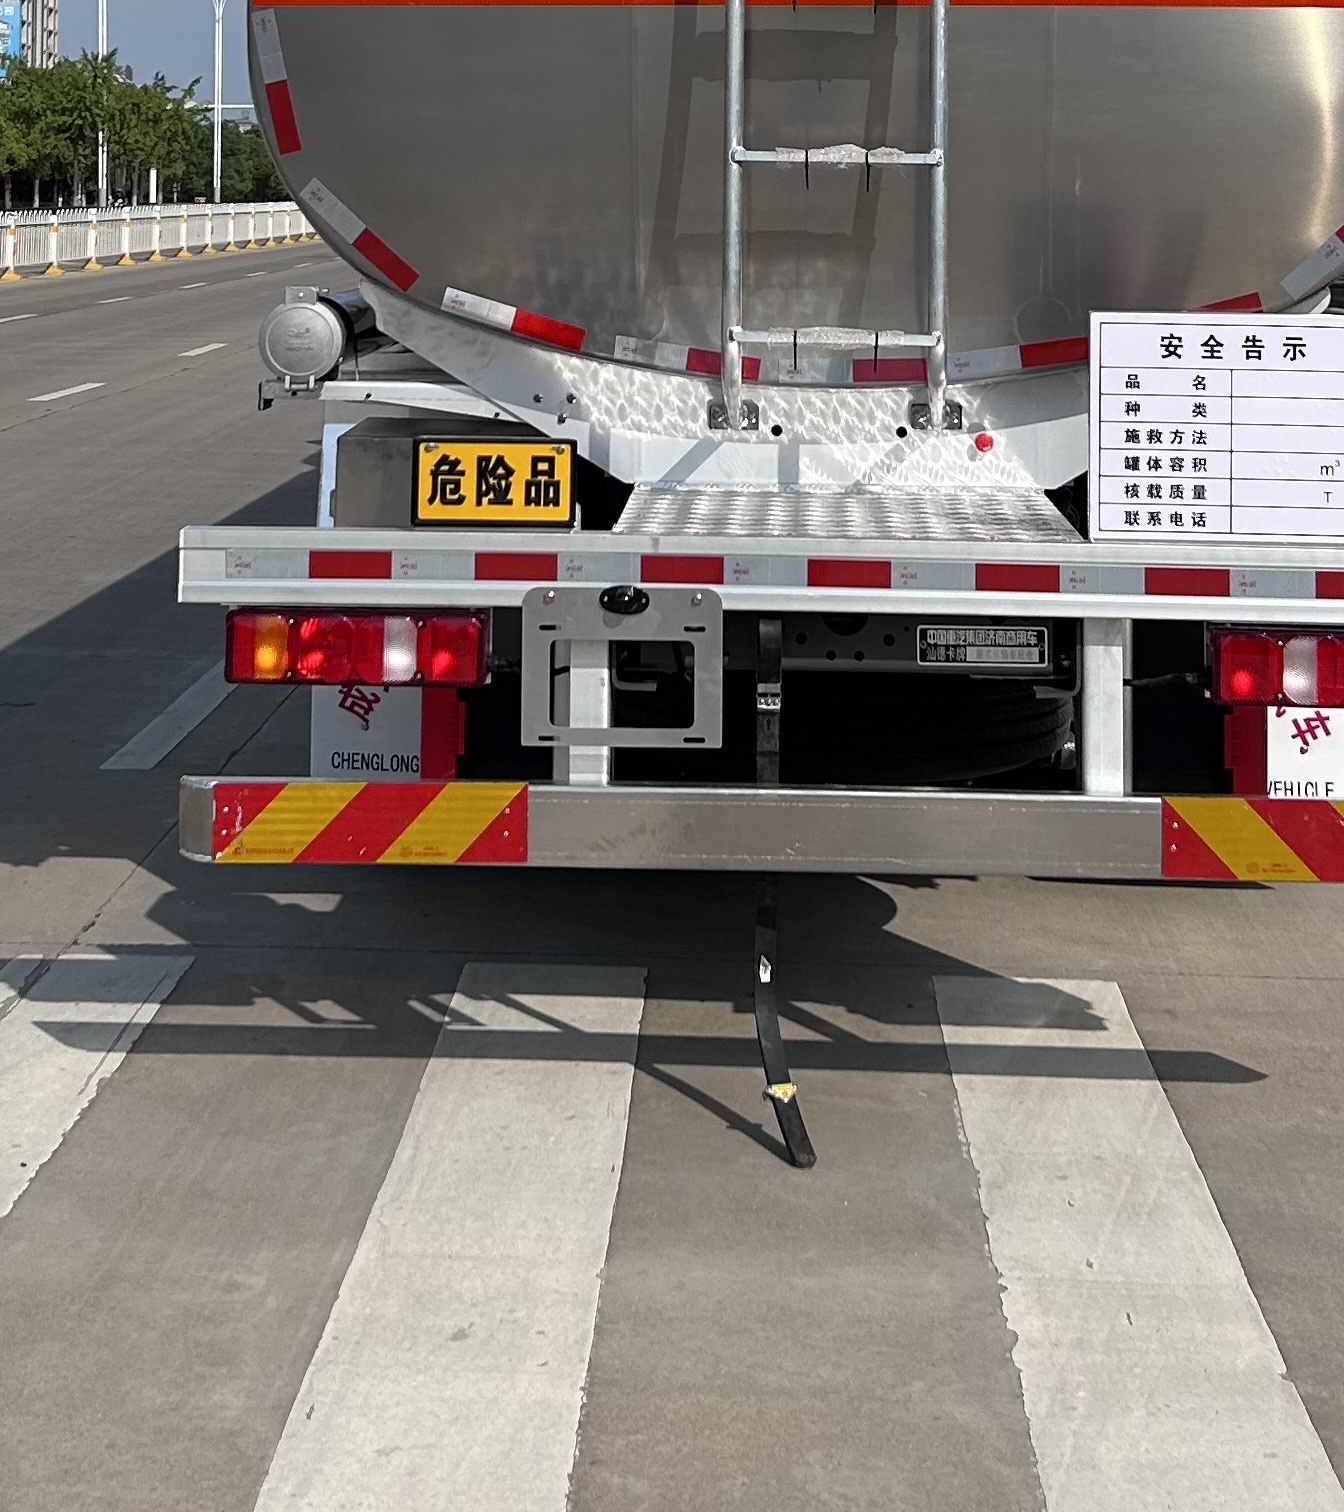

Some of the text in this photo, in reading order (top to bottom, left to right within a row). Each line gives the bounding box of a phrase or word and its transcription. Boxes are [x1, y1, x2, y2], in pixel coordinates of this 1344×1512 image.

[1160, 333, 1307, 362] 安全告示
[1123, 429, 1208, 445] 施救方法
[1123, 456, 1208, 473] 罐体容积
[427, 453, 562, 507] 危险品
[1123, 482, 1333, 503] 核载质量 T
[1123, 510, 1208, 528] 联系电话
[331, 751, 420, 773] CHENGLONG
